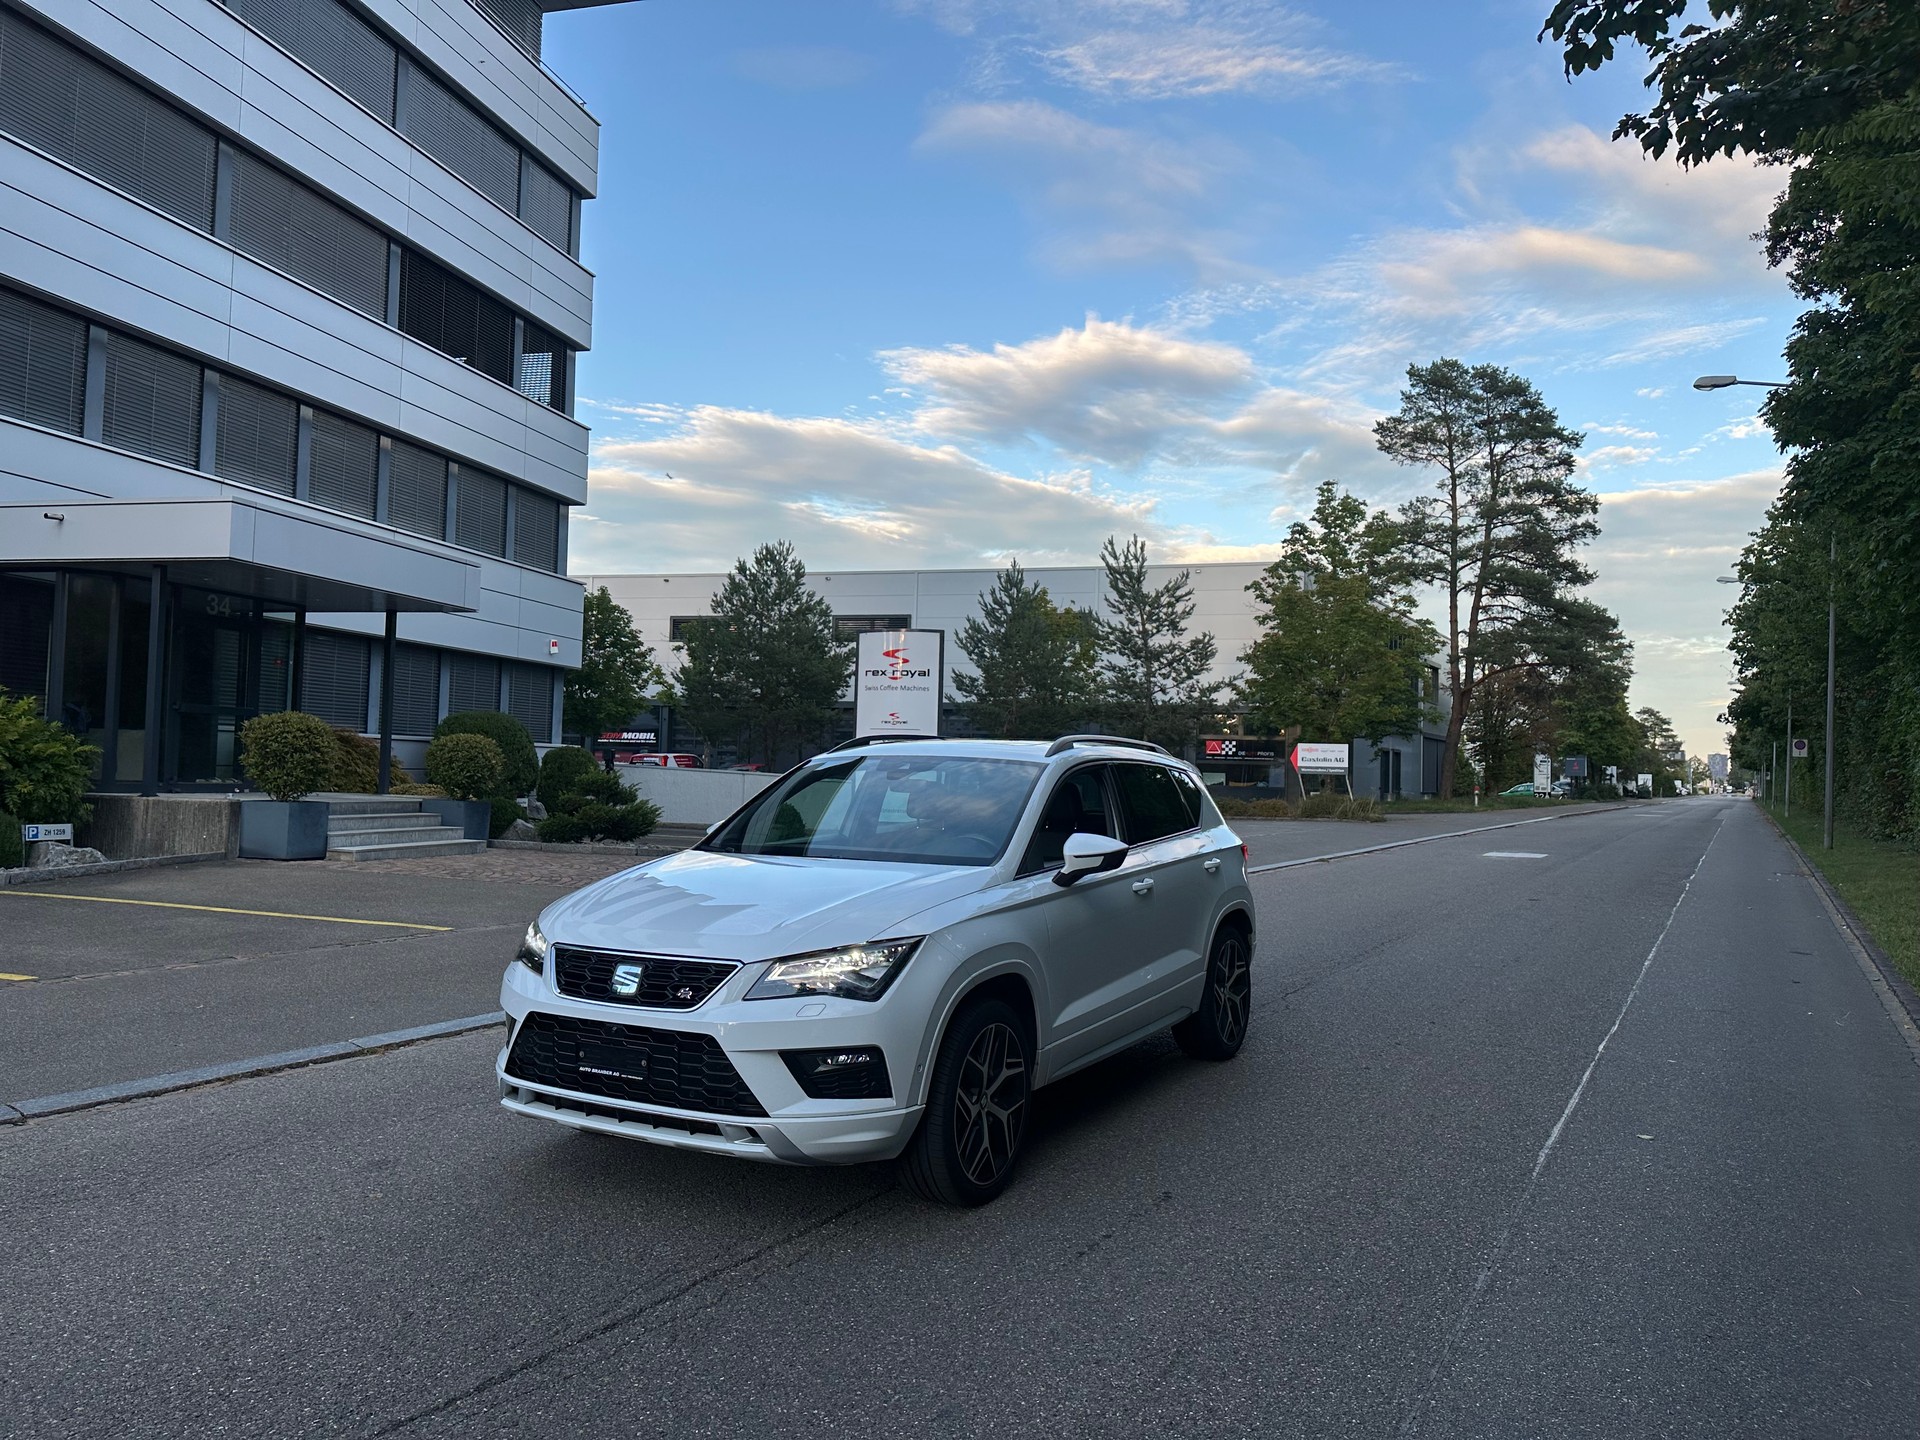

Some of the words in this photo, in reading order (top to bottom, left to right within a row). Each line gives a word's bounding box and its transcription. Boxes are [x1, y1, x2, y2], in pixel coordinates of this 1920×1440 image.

[206, 593, 231, 617] 34
[865, 669, 887, 677] rex
[892, 668, 930, 679] royal
[28, 827, 37, 838] P
